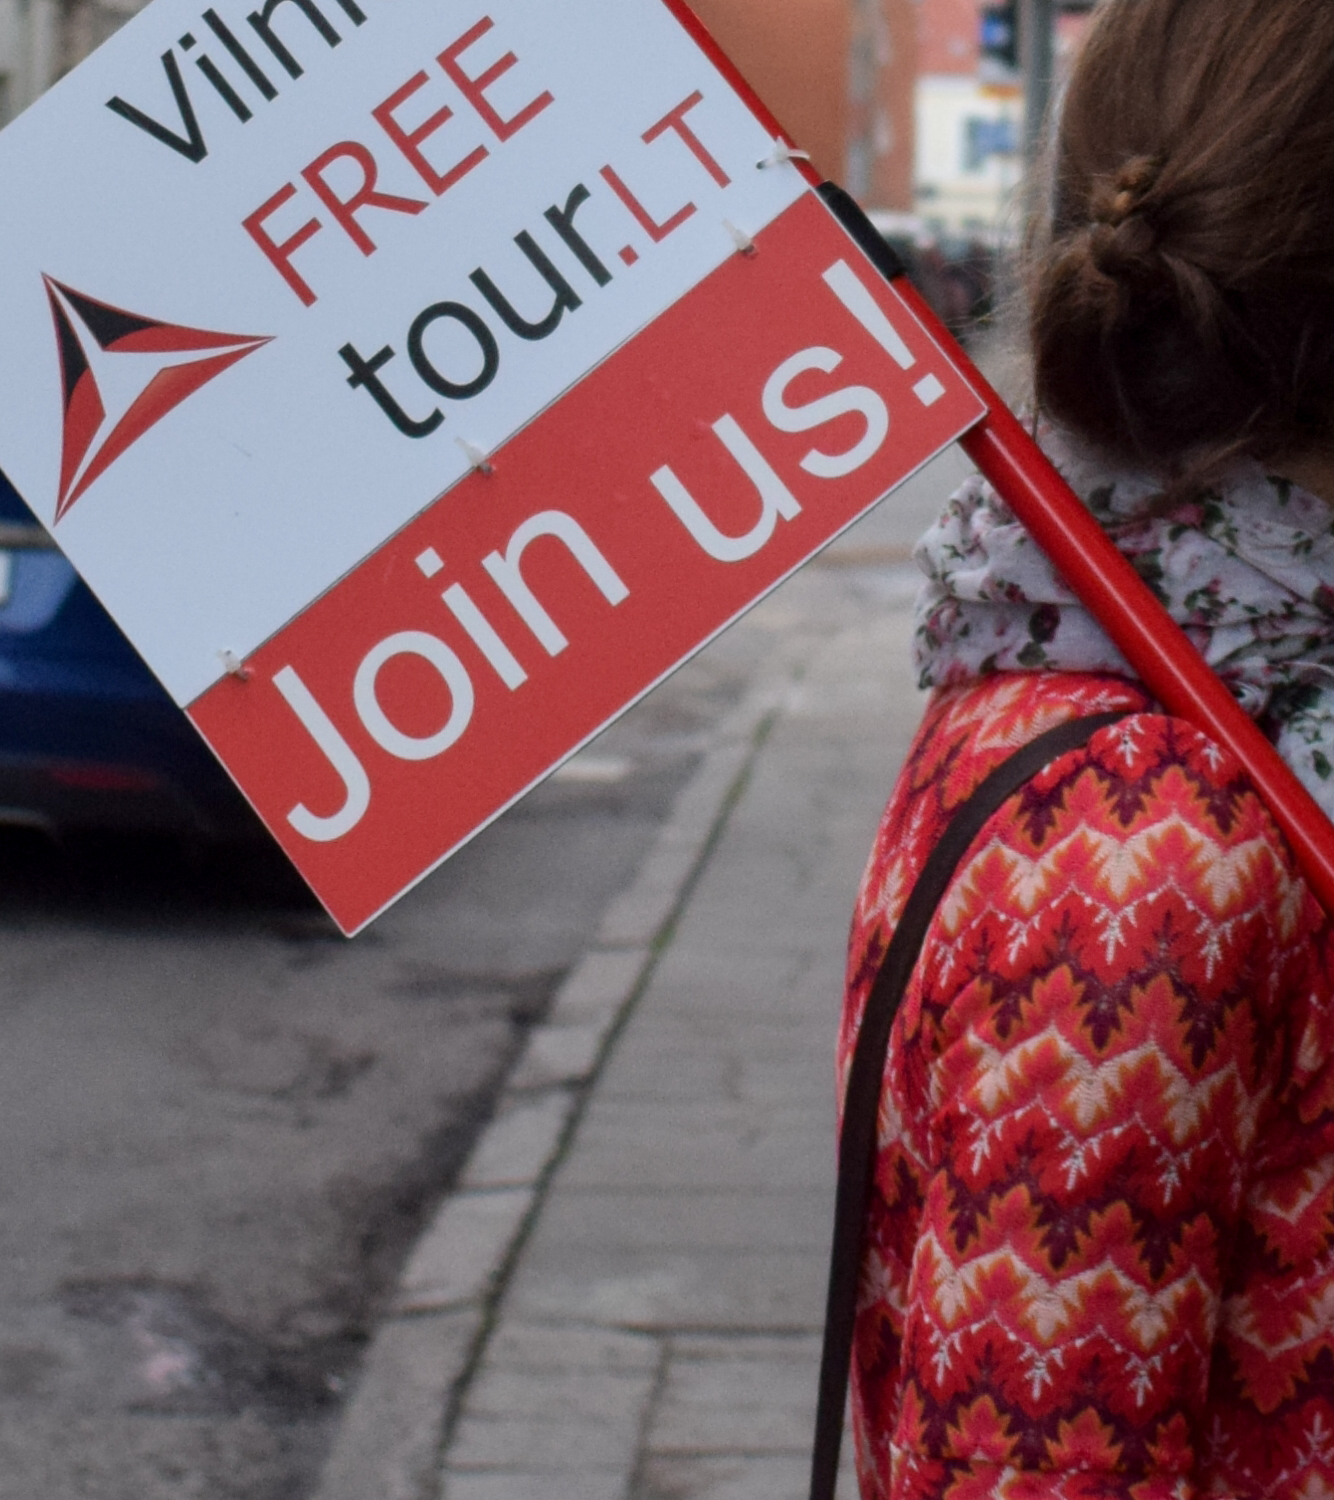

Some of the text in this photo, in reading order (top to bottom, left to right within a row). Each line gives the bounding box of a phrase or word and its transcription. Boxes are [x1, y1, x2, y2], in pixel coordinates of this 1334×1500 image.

[240, 15, 555, 308] FREE
[337, 90, 733, 440] tour.LT
[270, 260, 948, 844] Join us!
